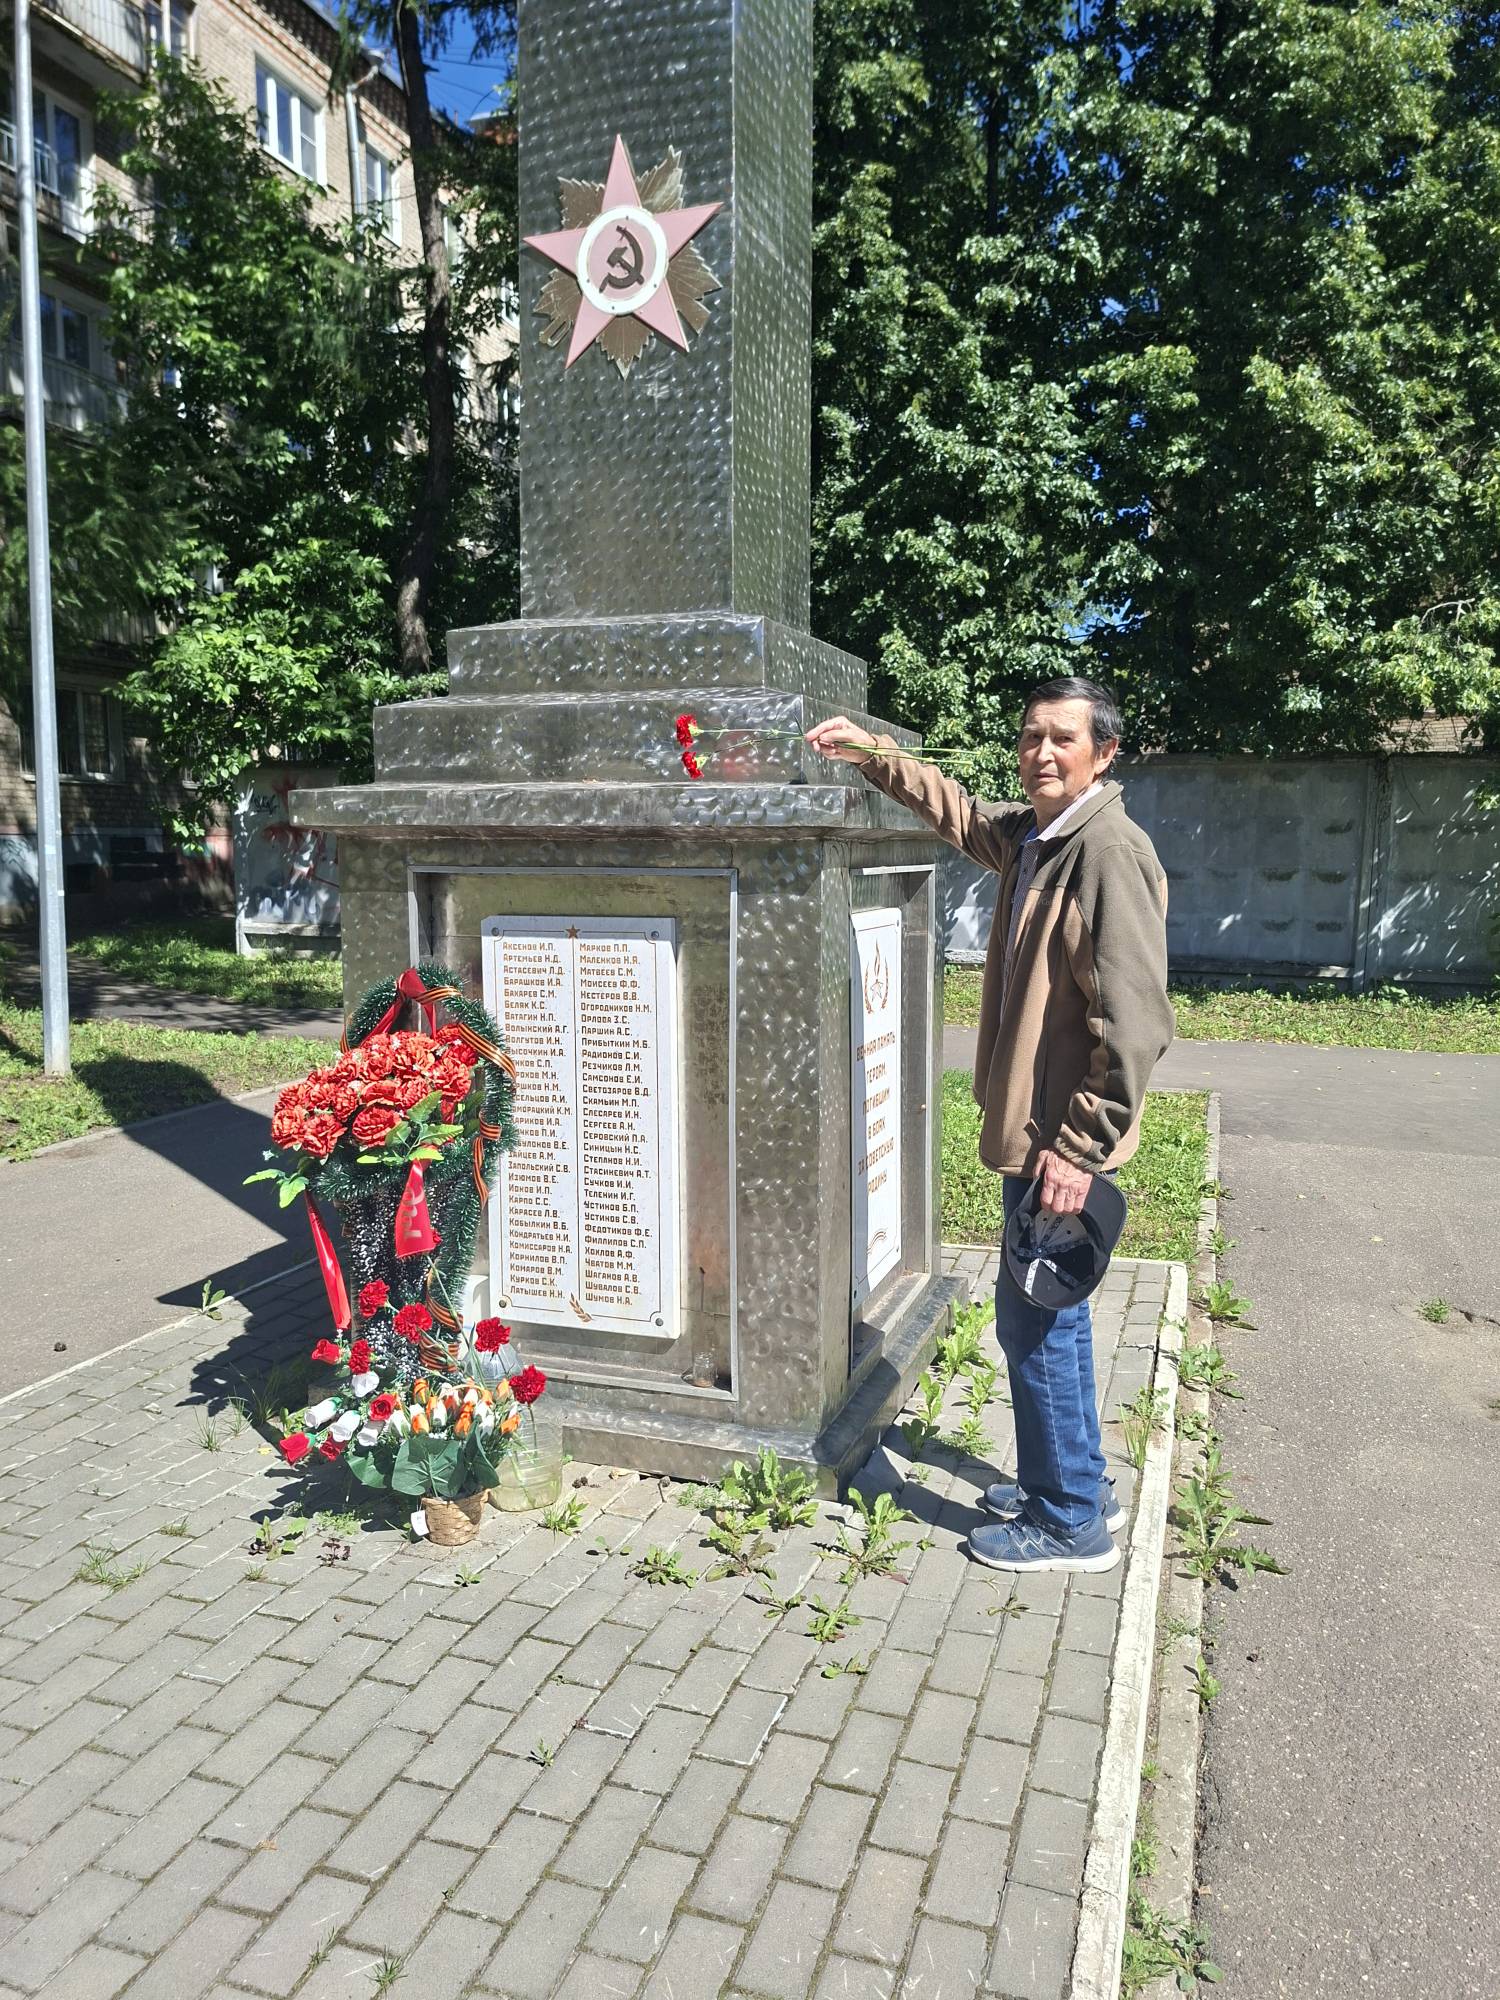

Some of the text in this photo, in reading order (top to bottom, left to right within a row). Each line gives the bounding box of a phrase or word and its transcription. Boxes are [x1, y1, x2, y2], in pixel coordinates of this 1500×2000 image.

[502, 943, 537, 951] АКСЕНОВ
[580, 944, 611, 952] МАРКОВ
[503, 954, 543, 963] АРТЕМЬЕВ
[580, 955, 621, 964] МАЛЕНКОВ
[580, 967, 616, 976] МАТВЕЕВ
[503, 977, 545, 986] БАРАШКОВ
[580, 979, 618, 988] МОИСЕЕВ
[504, 988, 538, 998] БАХАРЕВ
[580, 991, 621, 1000] НЕСТЕРОВ
[504, 1000, 530, 1009] БЕЛЯК
[580, 1003, 633, 1013] ОГОРОДНИКОВ
[504, 1011, 538, 1021] ВАТАГИН
[580, 1014, 612, 1024] ОРЛОВА
[504, 1022, 553, 1033] ВОЛЫНСКИЙ
[581, 1026, 615, 1036] ПАРШИН
[581, 1038, 630, 1048] ПРИБЫТКИН
[504, 1047, 548, 1056] ВЫСОЧКИН
[581, 1049, 623, 1060] РАДИОНОВ
[581, 1061, 623, 1071] РЕЗЧИКОВ
[582, 1073, 624, 1083] САМСОНОВ
[582, 1085, 632, 1096] СВЕТОЗАРОВ
[582, 1096, 620, 1107] СКАМЬИН
[582, 1108, 623, 1118] СЛЕСАРЕВ
[583, 1119, 617, 1130] СЕРГЕЕВ
[583, 1130, 630, 1142] СЕРОВСКИЙ
[583, 1143, 623, 1153] СИНИЦЫН
[583, 1155, 623, 1165] СТЕПАНОВ
[508, 1161, 554, 1172] ЗАПОЛЬСКИЙ
[508, 1173, 541, 1183] ИЗЮМОВ
[583, 1176, 615, 1188] СУЧКОВ
[508, 1193, 533, 1205] КАРПО
[583, 1189, 619, 1200] ТЕЛЕНИН
[508, 1206, 543, 1217] КАРАСЕВ
[583, 1201, 620, 1212] УСТИНОВ
[584, 1212, 620, 1223] УСТИНОВ
[509, 1218, 551, 1229] КОБЫЛКИН
[509, 1229, 554, 1241] КОНДРАТЬЕВ
[584, 1224, 632, 1236] ФЕДОТИКОВ
[509, 1241, 556, 1252] КОМИССАРОВ
[509, 1252, 550, 1263] КОРНИЛОВ
[509, 1263, 545, 1274] КОМАРОВ
[510, 1274, 540, 1285] КУРКОВ
[584, 1269, 622, 1281] ШАГАНОВ
[510, 1286, 547, 1297] ЛАТЫШЕВ
[585, 1281, 623, 1293] ШУВАЛОВ
[585, 1292, 615, 1304] ШУМОВ
